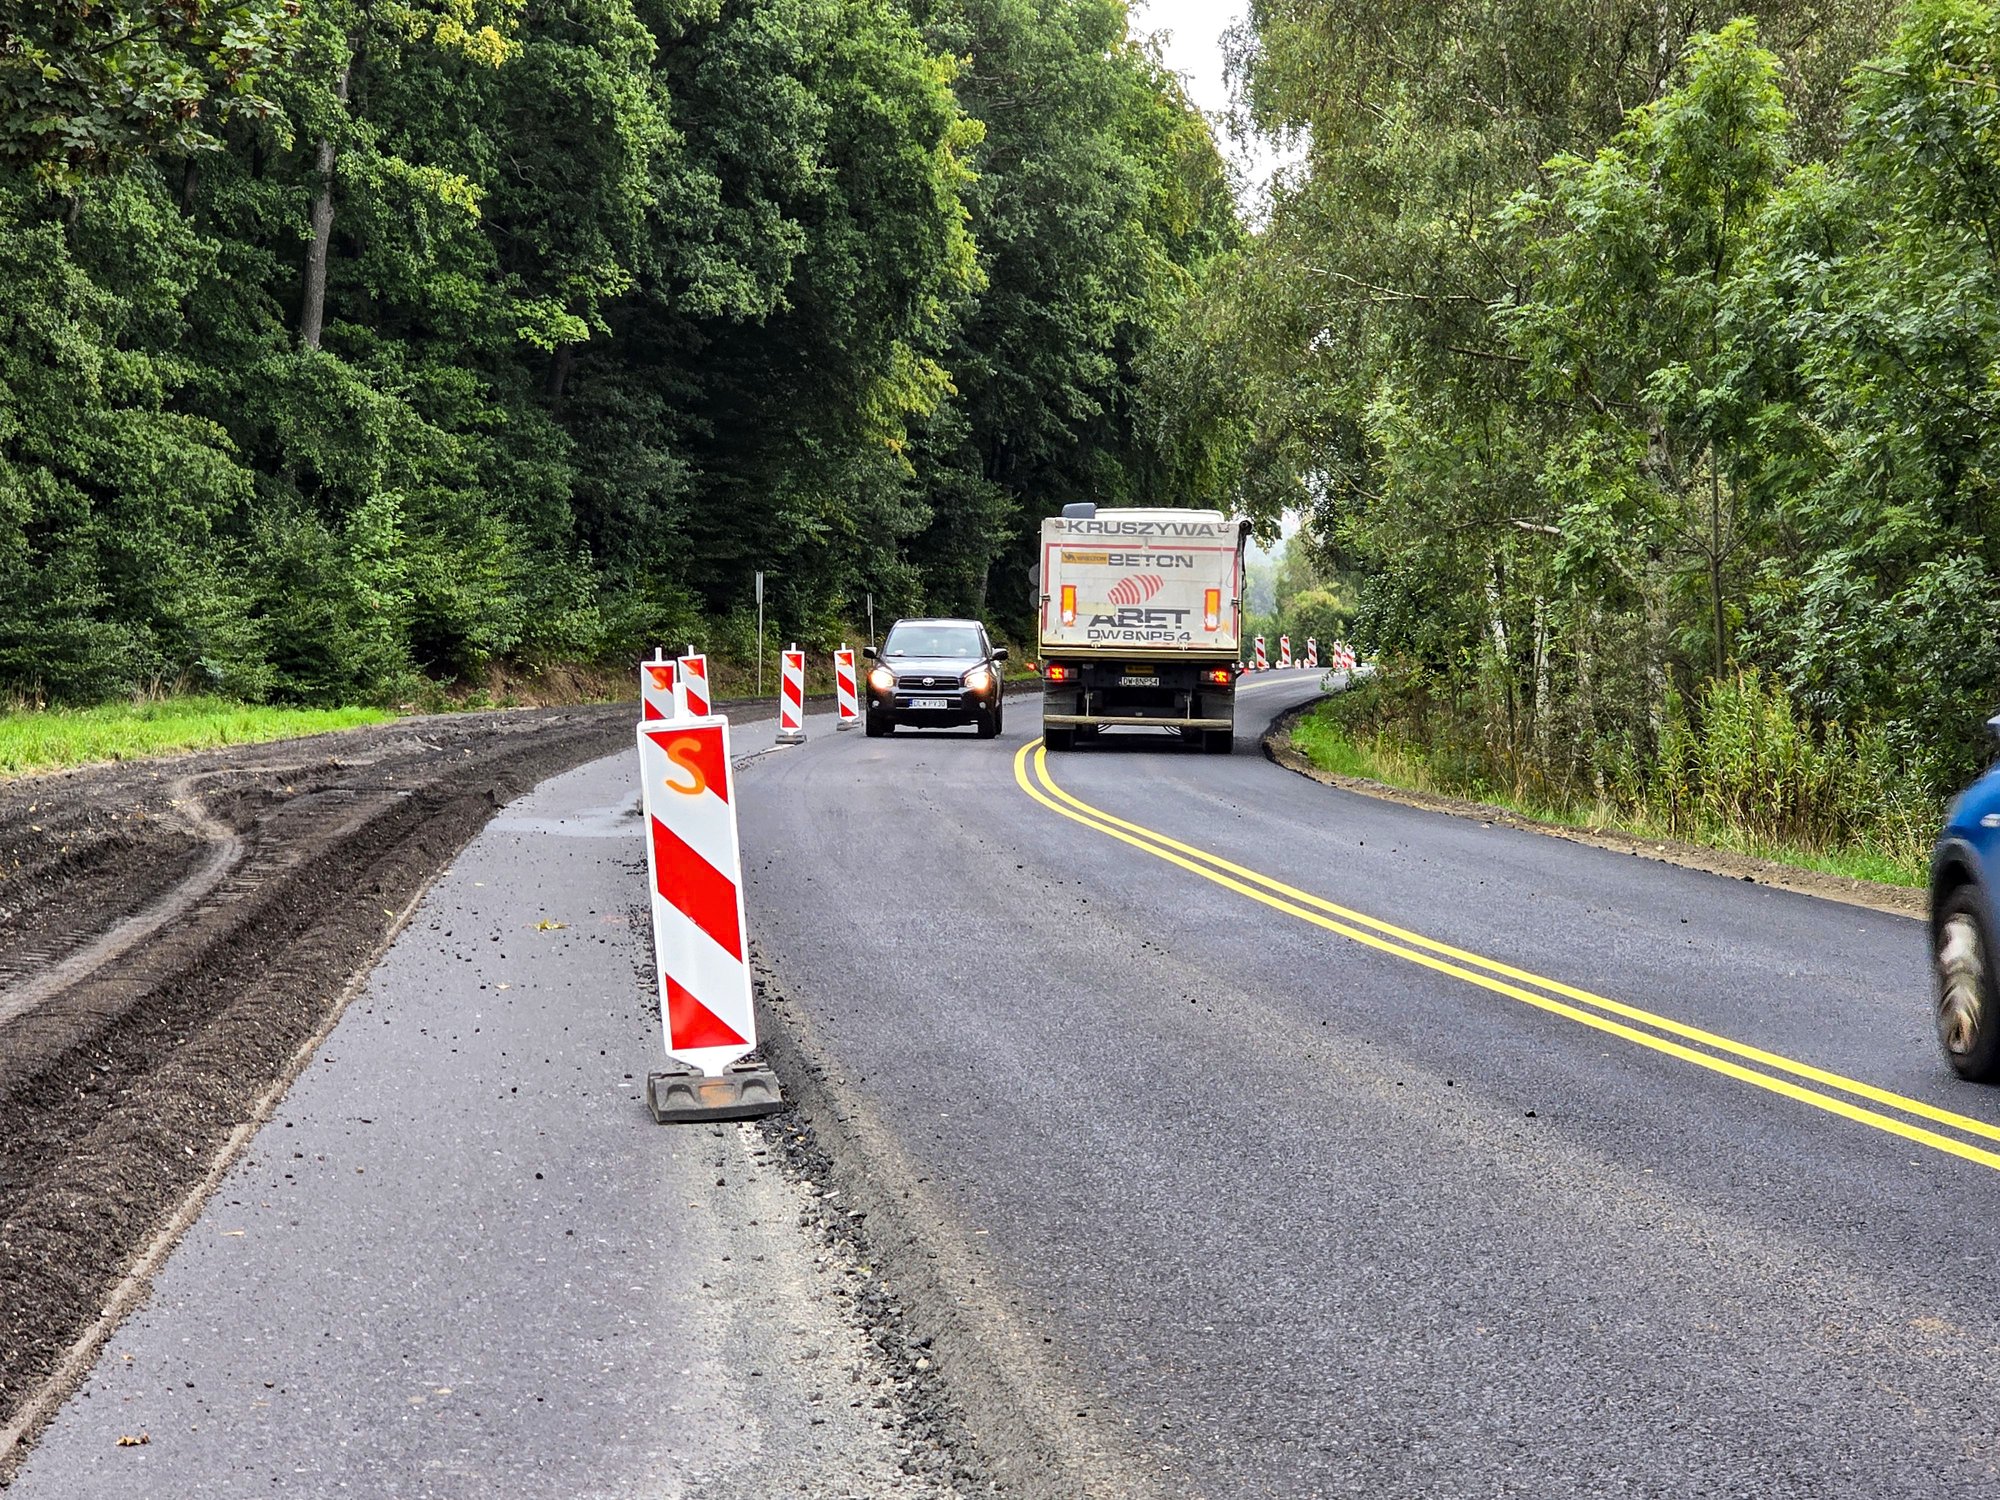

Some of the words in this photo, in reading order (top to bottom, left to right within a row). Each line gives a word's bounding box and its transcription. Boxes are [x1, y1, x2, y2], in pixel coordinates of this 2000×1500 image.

[1068, 520, 1215, 537] KRUSZYWA
[1108, 553, 1194, 568] BETON
[1088, 607, 1191, 629] ABET
[688, 660, 699, 676] S
[652, 667, 667, 691] S
[665, 737, 706, 796] S
